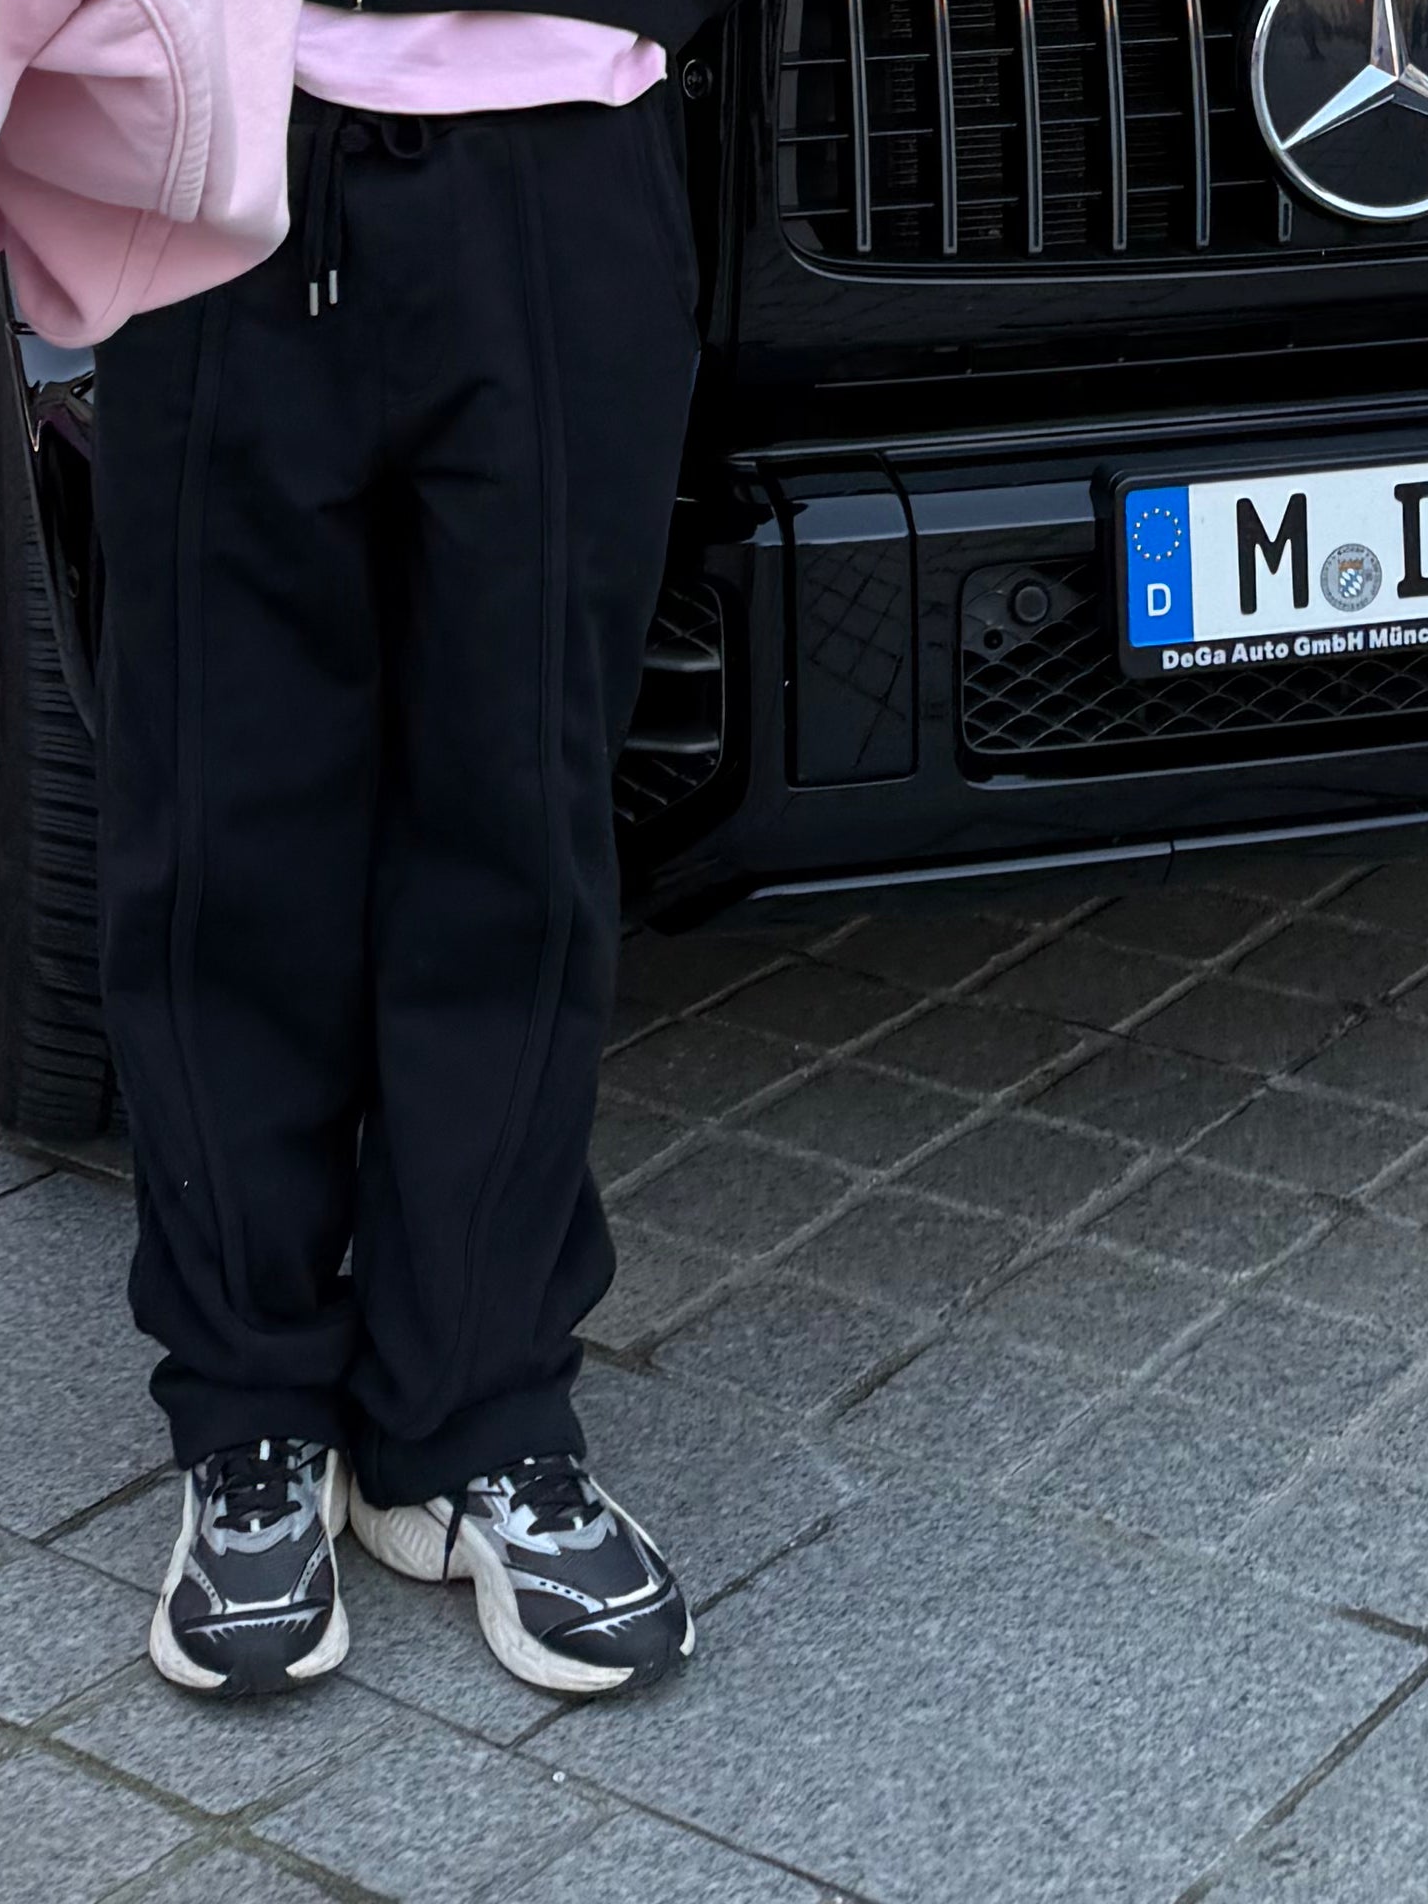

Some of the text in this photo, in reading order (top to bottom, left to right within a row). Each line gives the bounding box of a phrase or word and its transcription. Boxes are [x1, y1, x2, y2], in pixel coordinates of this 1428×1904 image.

[1235, 492, 1310, 615] M
[1147, 583, 1172, 617] D
[1162, 645, 1227, 670] DeGa
[1231, 642, 1289, 664] Auto
[1294, 631, 1364, 657] GmbH
